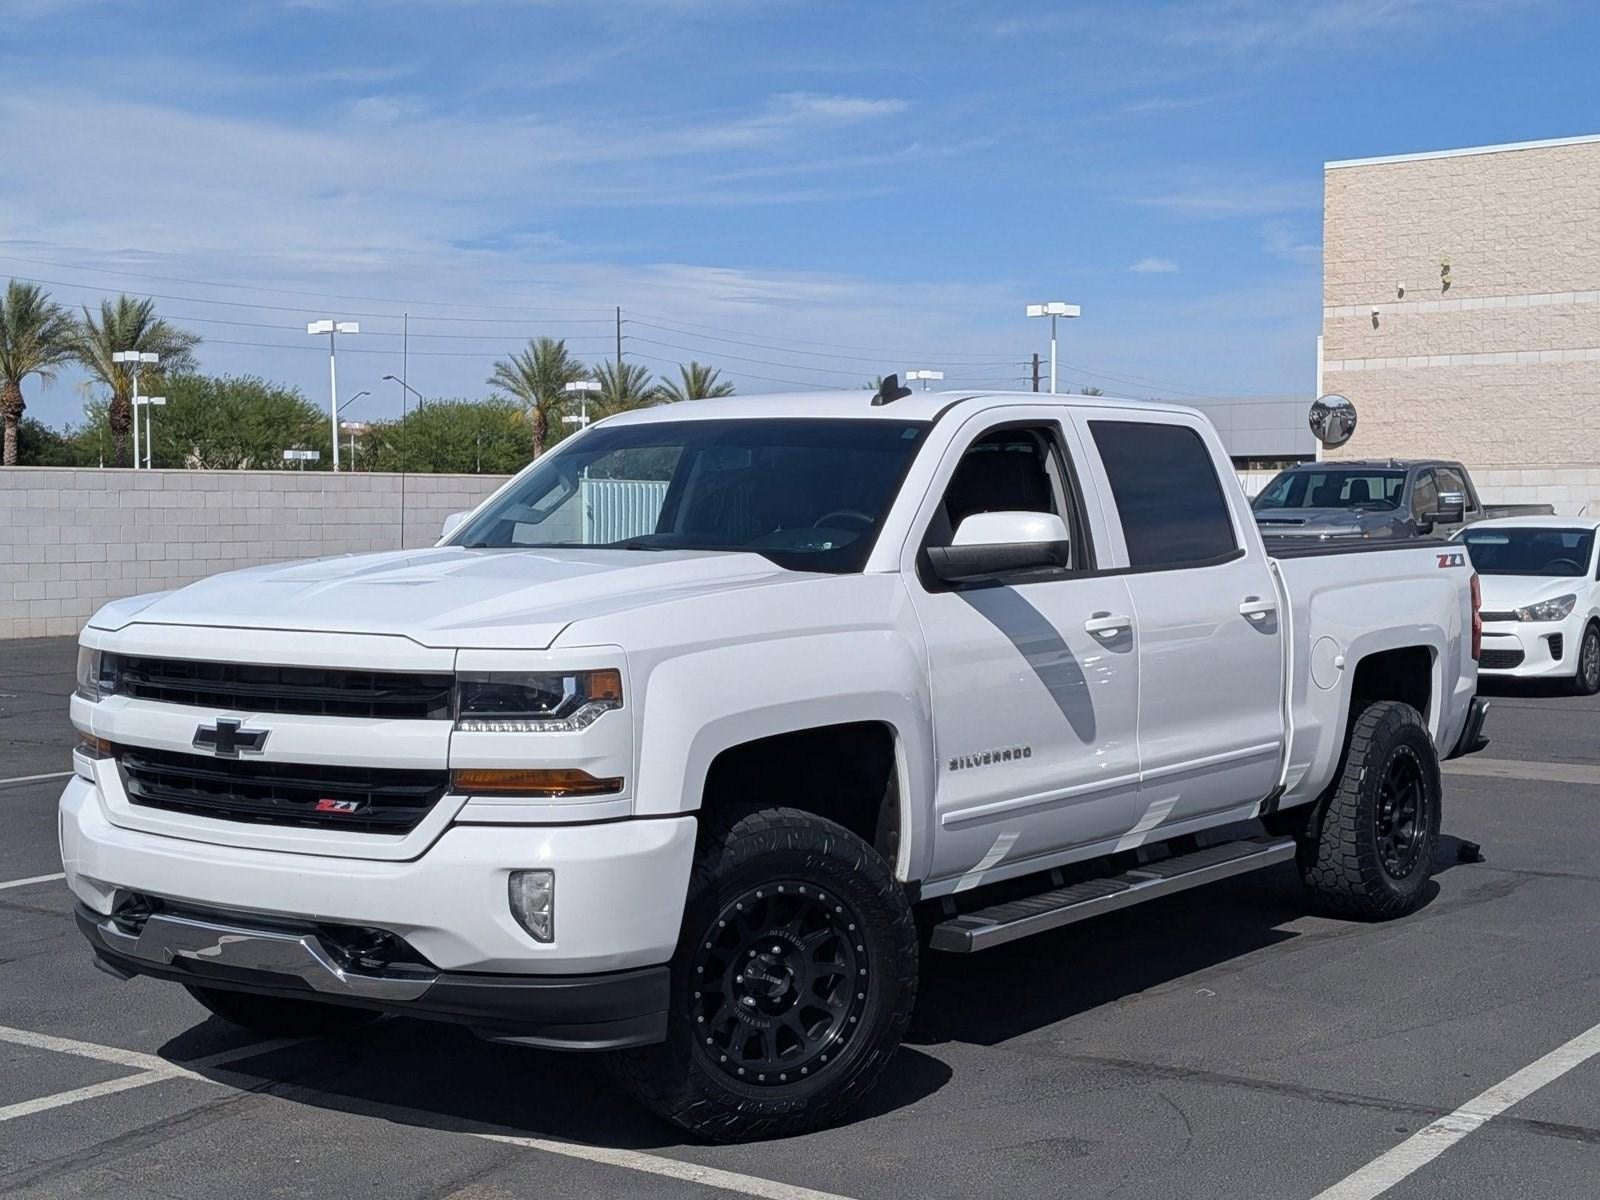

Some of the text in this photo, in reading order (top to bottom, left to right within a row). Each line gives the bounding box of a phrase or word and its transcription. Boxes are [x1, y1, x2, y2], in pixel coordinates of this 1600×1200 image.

[1436, 553, 1466, 568] Z71
[949, 746, 1032, 771] SILVERADO
[315, 799, 360, 813] Z71
